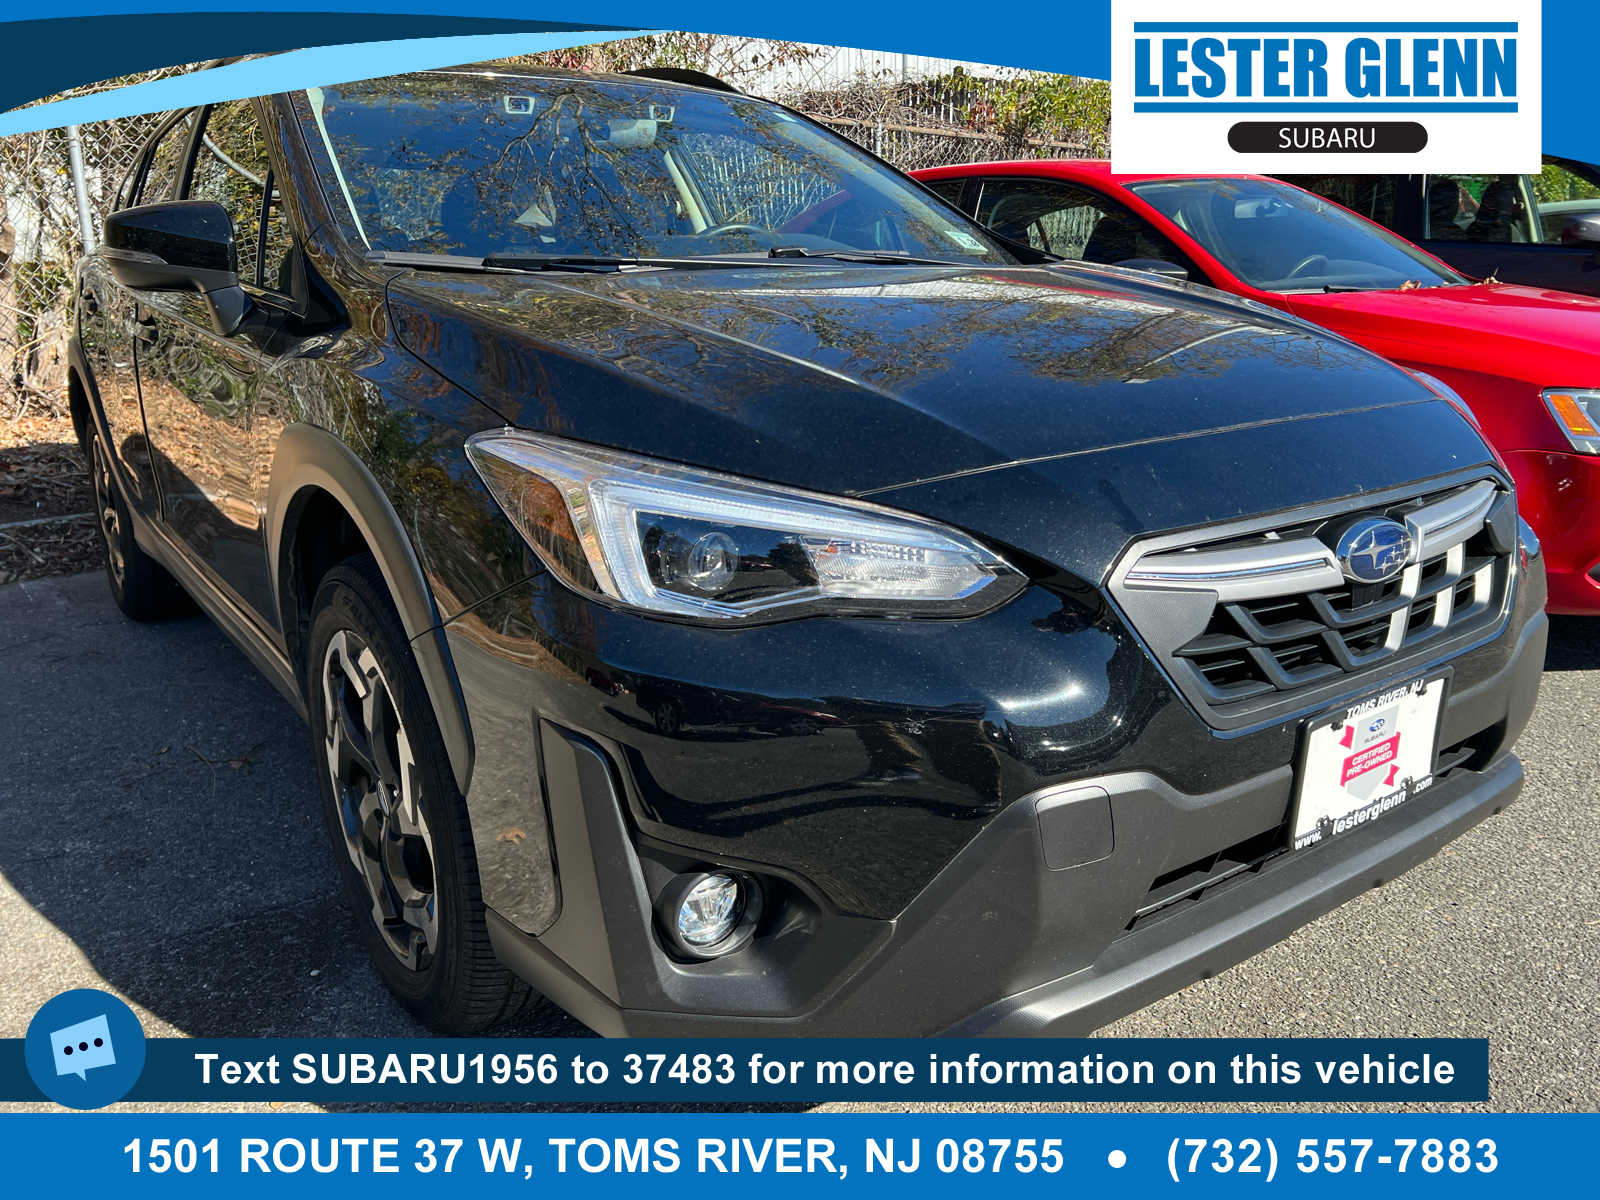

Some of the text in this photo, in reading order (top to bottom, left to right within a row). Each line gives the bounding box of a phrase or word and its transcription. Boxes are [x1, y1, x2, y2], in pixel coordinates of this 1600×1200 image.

[1346, 698, 1377, 720] TOMS
[1410, 678, 1425, 695] NJ
[1346, 750, 1393, 778] PRE-OWNED
[1351, 742, 1391, 766] CERTIFIED
[1331, 790, 1407, 836] lesterglenn
